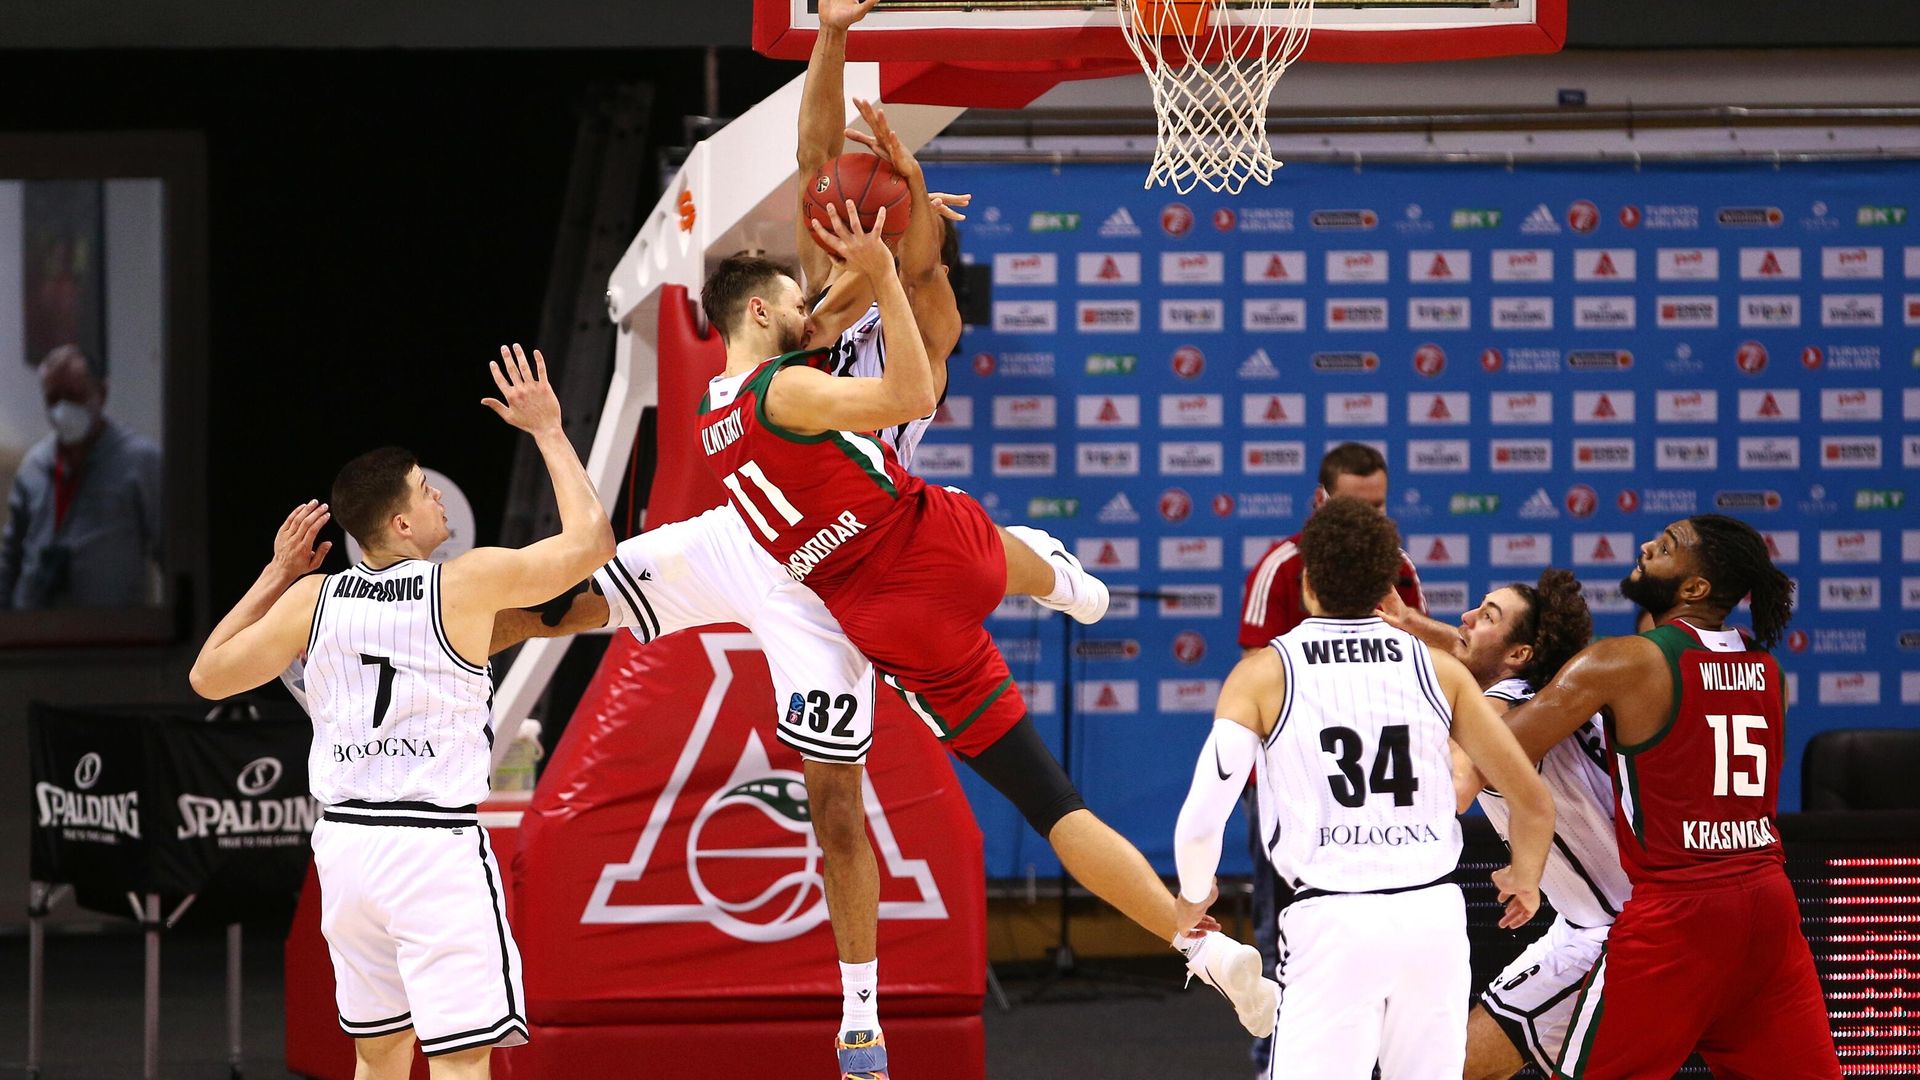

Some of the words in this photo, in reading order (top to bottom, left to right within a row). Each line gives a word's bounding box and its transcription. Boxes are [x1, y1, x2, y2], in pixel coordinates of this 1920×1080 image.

[722, 459, 804, 542] 11
[1302, 637, 1404, 665] WEEMS
[1699, 662, 1766, 691] WILLIAMS
[359, 653, 397, 729] 7
[807, 689, 858, 738] 32
[1319, 724, 1419, 808] 34
[1705, 714, 1769, 797] 15
[36, 781, 142, 840] SPALDING
[1320, 824, 1440, 847] BOLOGNA
